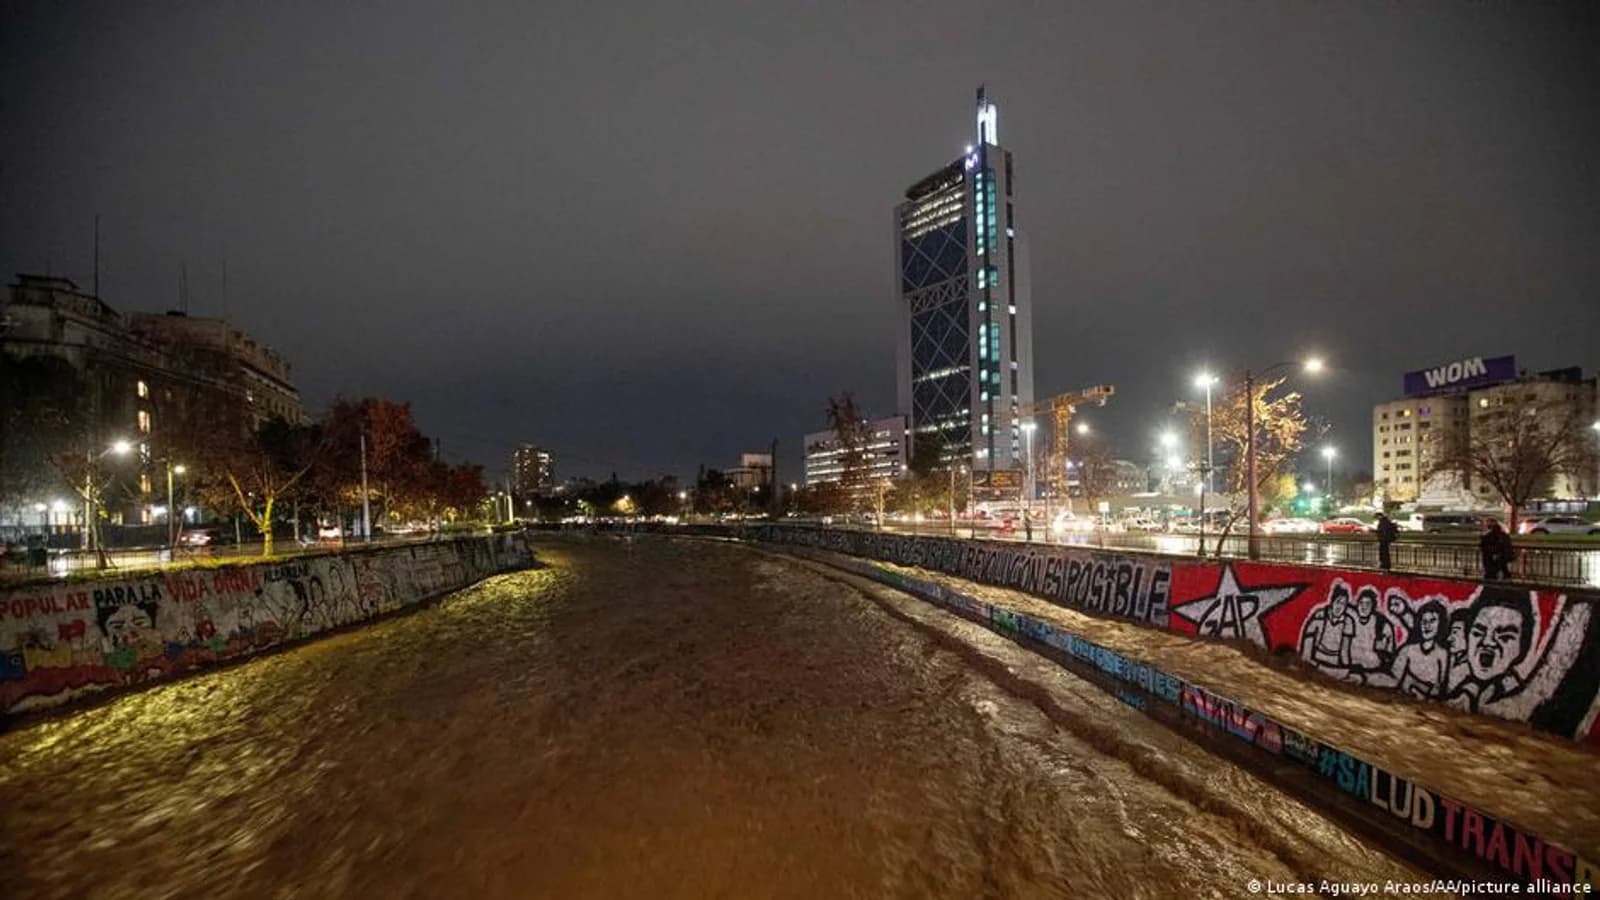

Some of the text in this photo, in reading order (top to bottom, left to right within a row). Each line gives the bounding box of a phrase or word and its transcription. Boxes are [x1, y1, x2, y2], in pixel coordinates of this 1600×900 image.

[1424, 357, 1488, 388] WOM
[0, 591, 90, 620] POPULAR
[94, 585, 138, 609] PARA
[140, 583, 162, 601] LA
[165, 574, 207, 601] VIDA
